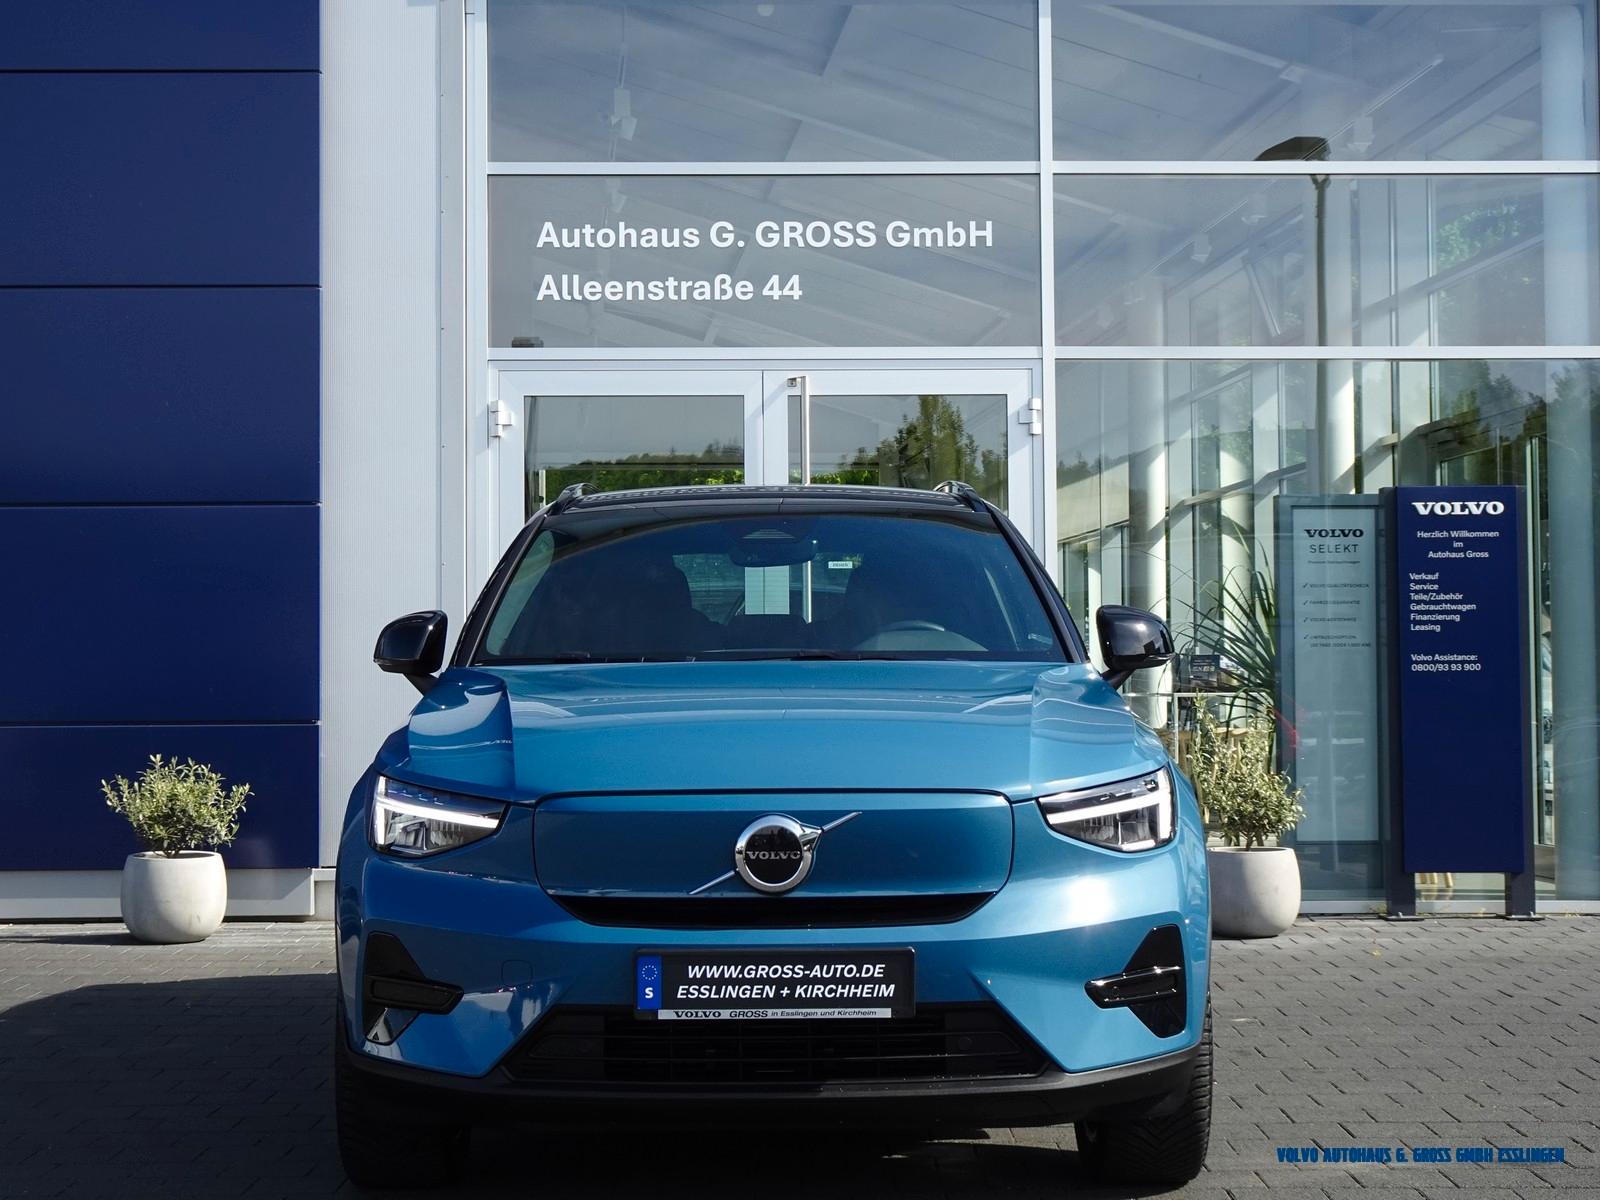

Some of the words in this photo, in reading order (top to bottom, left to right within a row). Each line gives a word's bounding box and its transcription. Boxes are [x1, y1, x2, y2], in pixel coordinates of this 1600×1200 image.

[536, 221, 700, 248] Autohaus
[709, 221, 746, 248] G.
[755, 221, 877, 248] GROSS
[885, 220, 994, 248] GmbH
[536, 273, 754, 301] Alleenstraße
[762, 274, 803, 300] 44
[1411, 501, 1505, 515] VOLVO
[1303, 528, 1364, 538] VOLVO
[1416, 530, 1449, 538] Herzlich
[1450, 530, 1500, 538] Willkommen
[1309, 544, 1359, 553] SELEKT
[1428, 550, 1465, 558] Autohaus
[1466, 550, 1489, 558] Gross
[1409, 572, 1439, 580] Verkauf
[1409, 582, 1439, 590] Service
[1409, 592, 1464, 601] Teile/Zubehör
[1410, 603, 1477, 611] Gebrauchtwagen
[1410, 613, 1460, 622] Finanzierung
[1410, 623, 1441, 632] Leasing
[1433, 653, 1478, 661] Assistance:
[1411, 663, 1449, 672] 0800/93
[1450, 663, 1462, 671] 93
[1463, 663, 1481, 671] 900
[746, 851, 801, 860] VOLVO
[687, 964, 886, 979] WWW.GROSS-AUTO.DE
[645, 987, 654, 999] S
[676, 985, 776, 999] ESSLINGEN
[794, 984, 896, 998] KIRCHHEIM
[673, 1010, 721, 1018] VOLVO
[729, 1010, 769, 1018] GROSS
[780, 1009, 818, 1017] Esslingen
[820, 1009, 835, 1017] und
